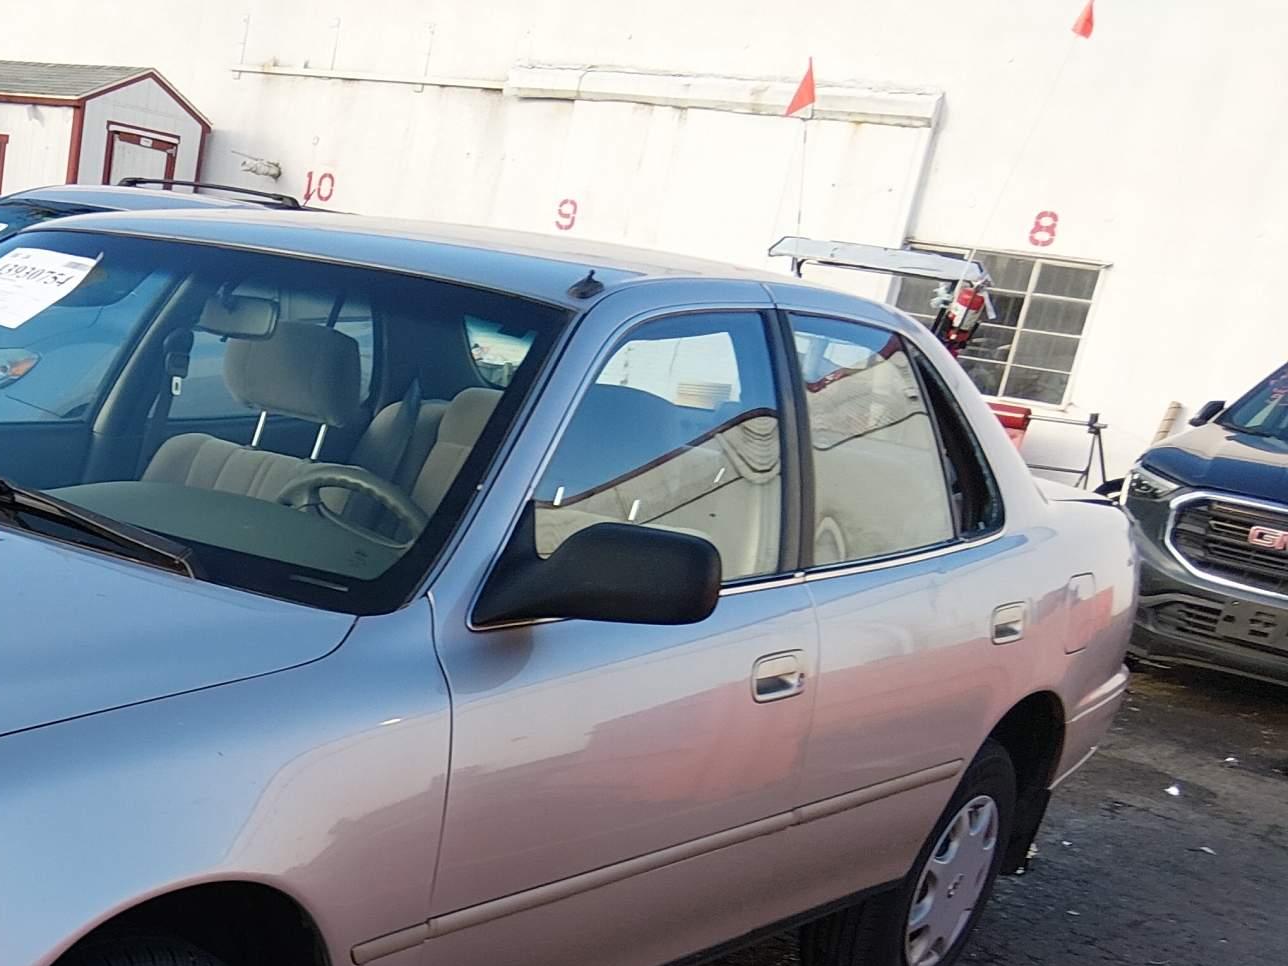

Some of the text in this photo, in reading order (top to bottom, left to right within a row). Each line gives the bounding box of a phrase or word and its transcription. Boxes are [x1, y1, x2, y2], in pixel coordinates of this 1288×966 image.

[304, 171, 335, 201] 10
[555, 199, 578, 230] 9
[1029, 211, 1059, 247] 8
